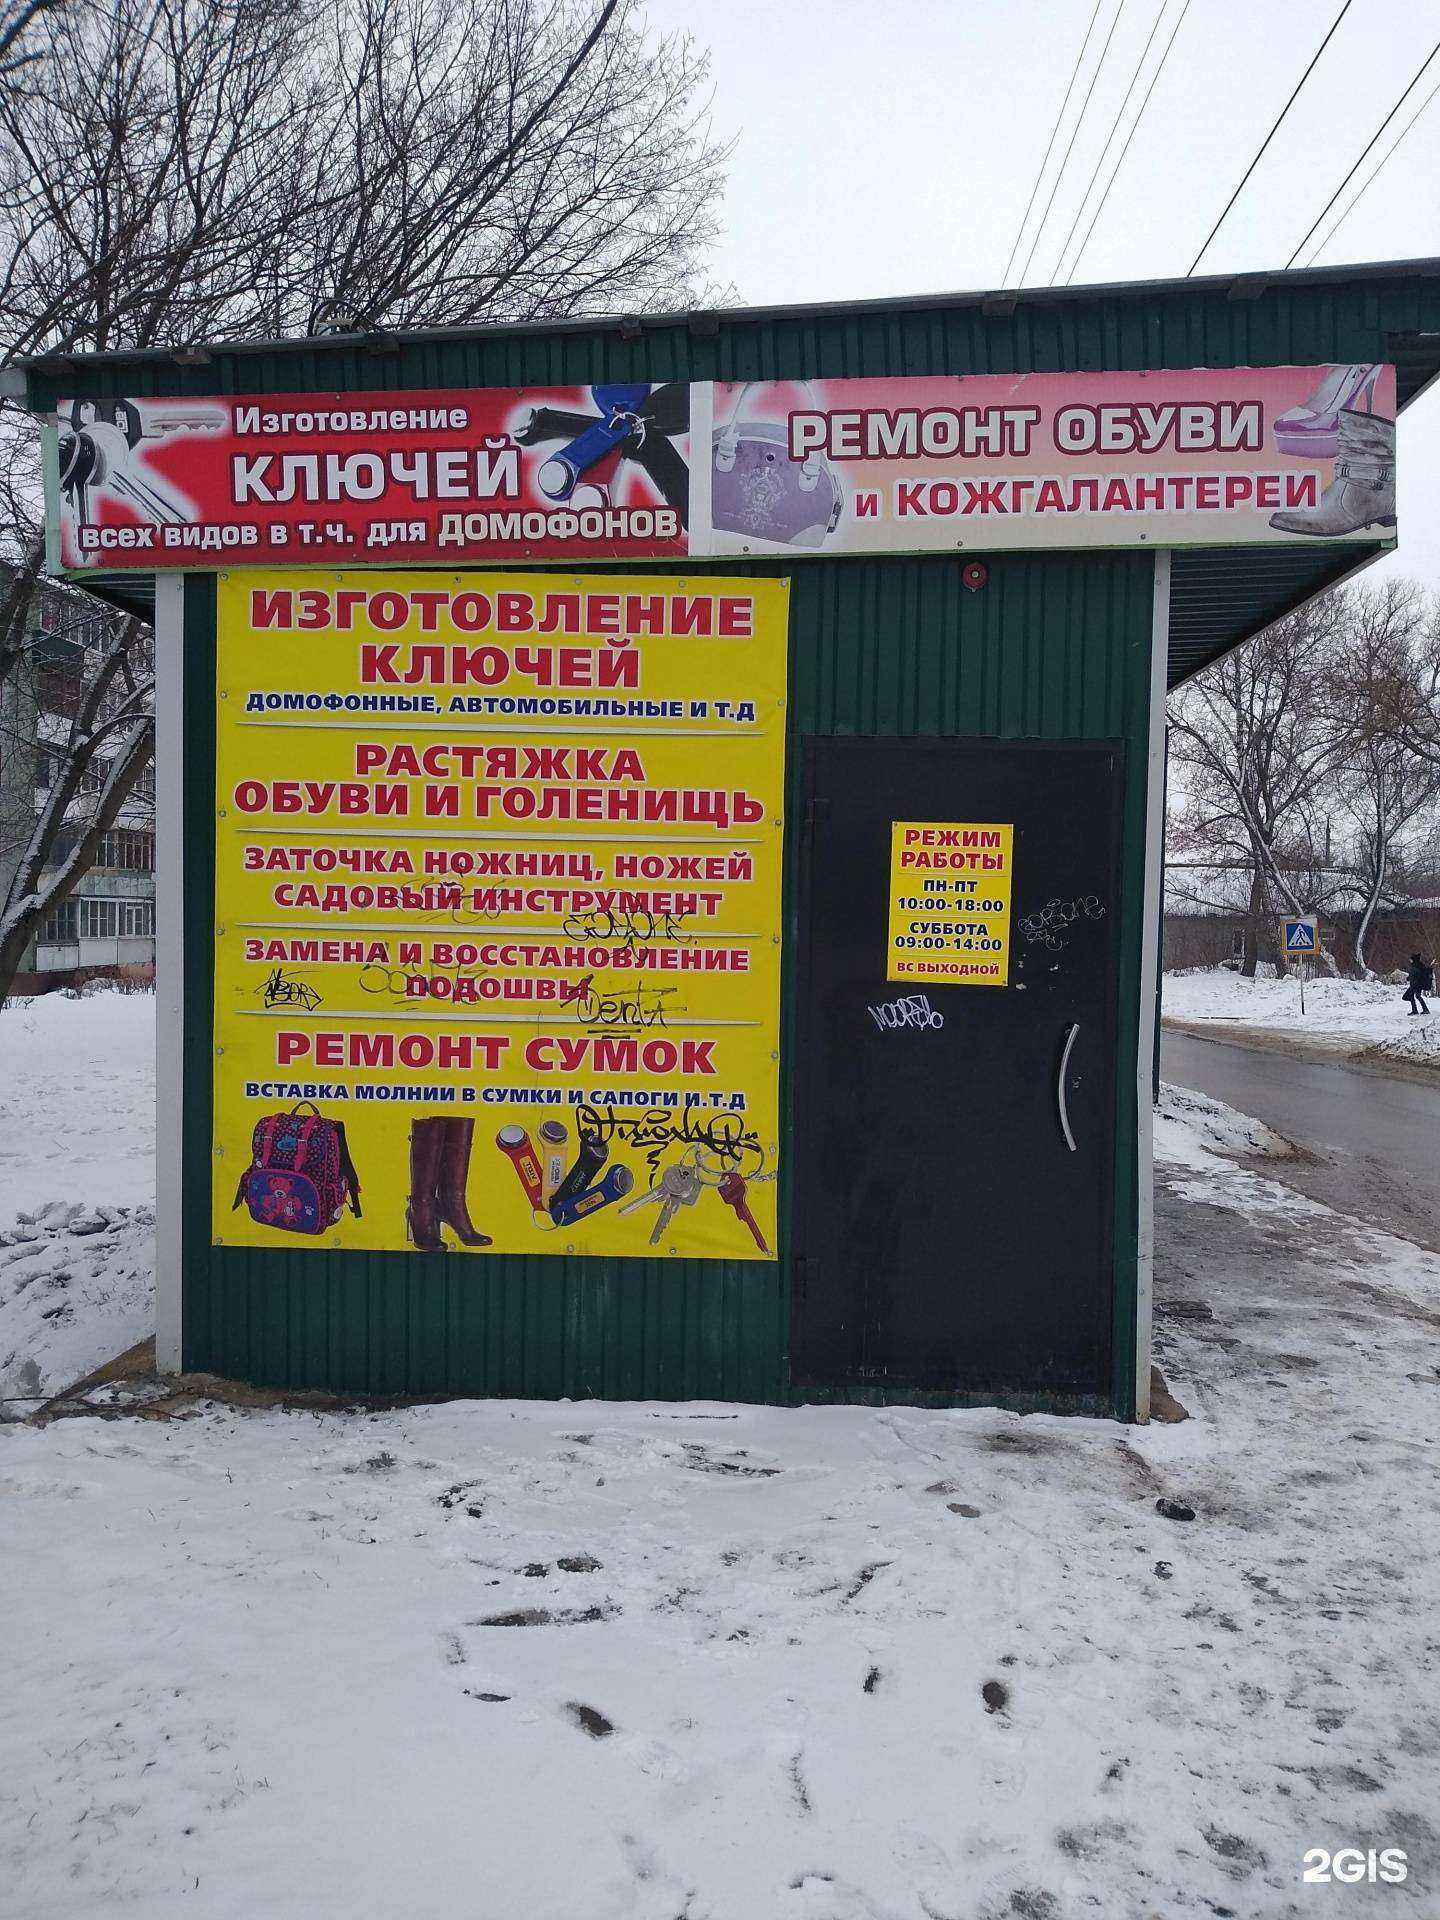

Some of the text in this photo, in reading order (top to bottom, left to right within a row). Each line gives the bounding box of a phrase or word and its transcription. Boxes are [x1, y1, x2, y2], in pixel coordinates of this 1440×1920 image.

[235, 407, 469, 434] Изготовление
[792, 405, 1263, 457] РЕМОНТ ОБУВИ
[233, 438, 520, 502] КЛЮЧЕЙ
[857, 475, 1318, 517] и КОЖГАЛАНТЕРЕИ
[82, 510, 678, 549] всех видов в т.ч. для ДОМОФОНОВ
[251, 590, 753, 636] ИЗГОТОВЛЕНИЕ
[361, 637, 639, 688] КЛЮЧЕЙ
[246, 693, 755, 721] ДОМОФОННЫЕ, АВТОМОБИЛЬНЫЕ И Т.Д
[356, 744, 645, 781] РАСТЯЖКА
[234, 781, 764, 829] ОБУВИ И ГОЛЕНИЩЬ
[905, 830, 1001, 848] РЕЖИМ
[245, 847, 753, 881] ЗАТОЧКА НОЖНИЦ, НОЖЕЙ
[901, 852, 1003, 870] РАБОТЫ
[274, 882, 462, 912] САДОВЫЙ
[473, 887, 723, 916] ИНСТРУМЕНТ
[923, 879, 978, 892] ПН-ПТ
[898, 898, 1003, 912] 10:00-18:00
[895, 936, 1002, 950] 09:00-14:00
[909, 922, 988, 935] СУББОТА
[245, 939, 749, 970] ЗАМЕНА И ВОССТАНОВЛЕНИЕ
[897, 962, 1000, 976] ВС ВЫХОДНОЙ
[406, 975, 589, 1002] ПОДОШВЫ
[277, 1032, 717, 1074] РЕМОНТ СУМОК
[245, 1082, 746, 1110] ВСТАВКА МОЛНИИ В СУМКИ И САПОГИ И.Т.Д
